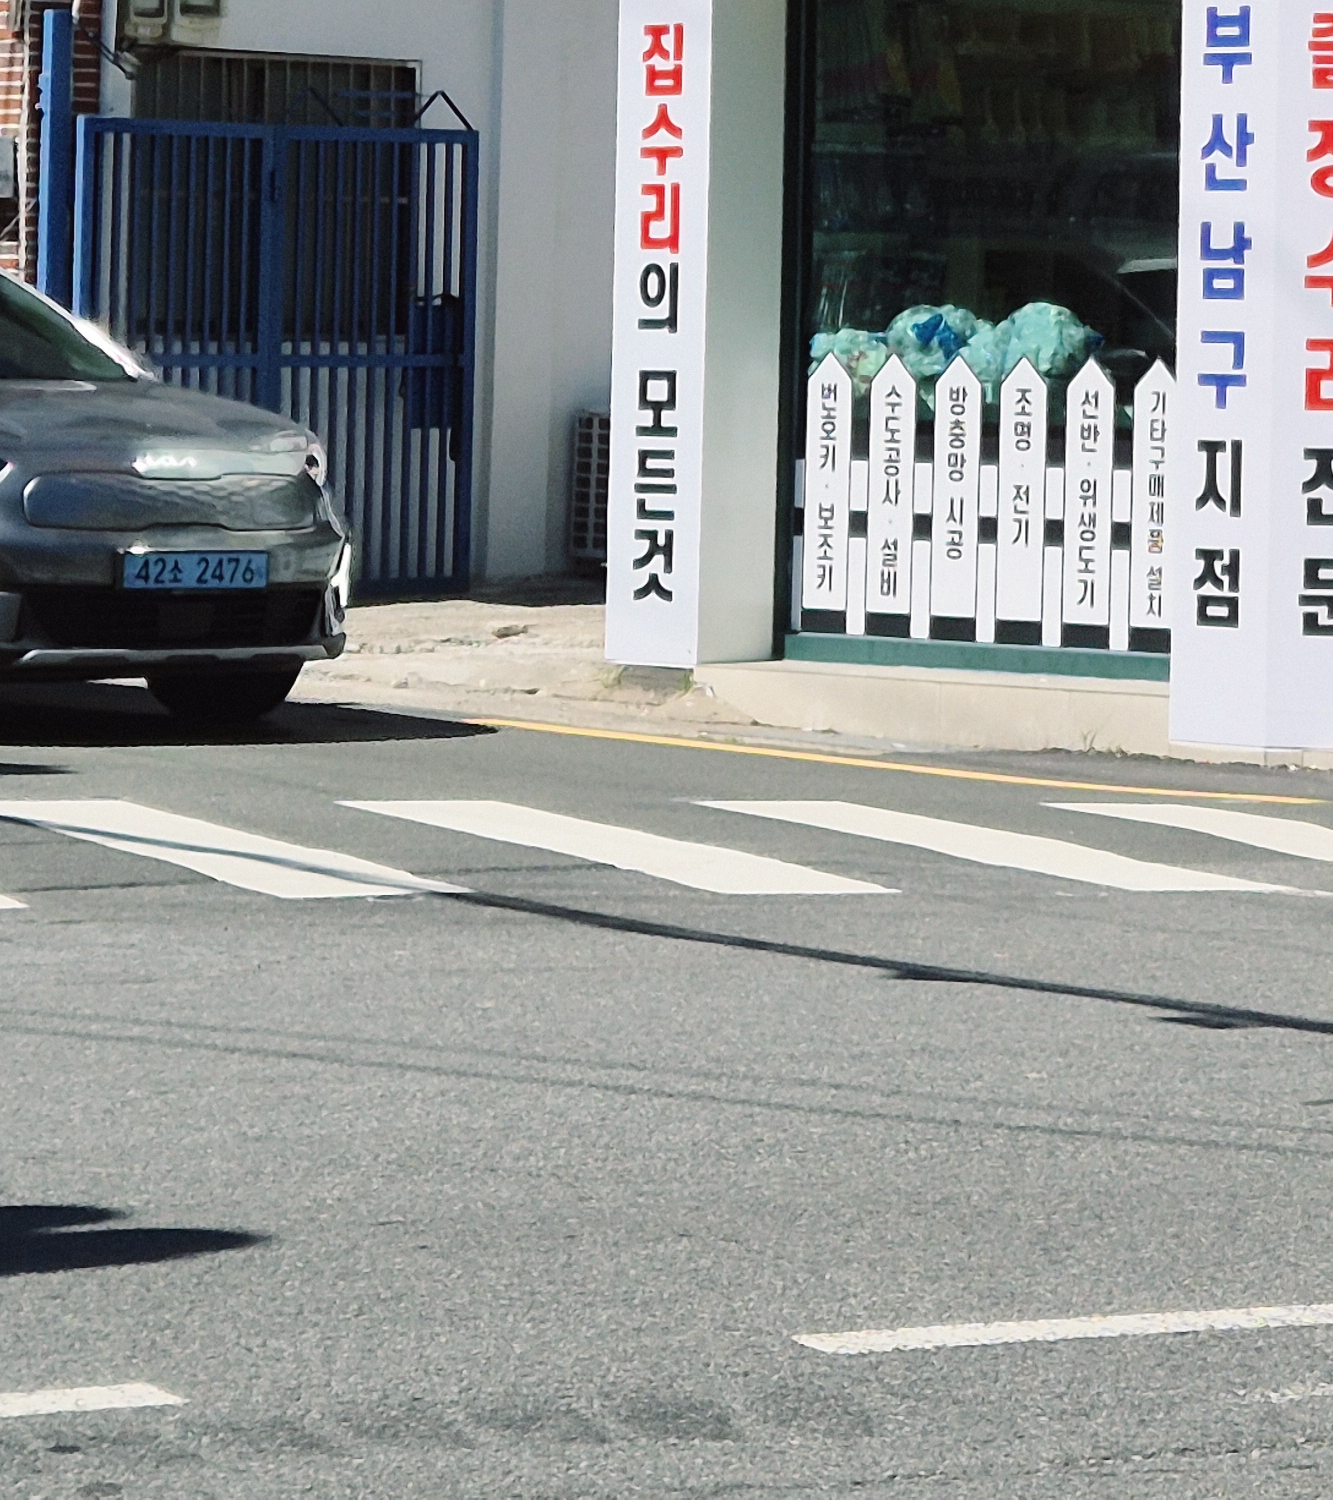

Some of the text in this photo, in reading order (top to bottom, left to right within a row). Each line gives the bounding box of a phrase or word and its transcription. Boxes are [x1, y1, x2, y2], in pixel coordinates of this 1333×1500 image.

[633, 21, 685, 605] 집수리의 모든것
[881, 384, 902, 507] 수도공사
[945, 385, 969, 561] 방충망 시공
[1011, 387, 1033, 549] 조명 전기
[1076, 389, 1100, 609] 선반 위생도기
[134, 557, 256, 584] 42소 2476
